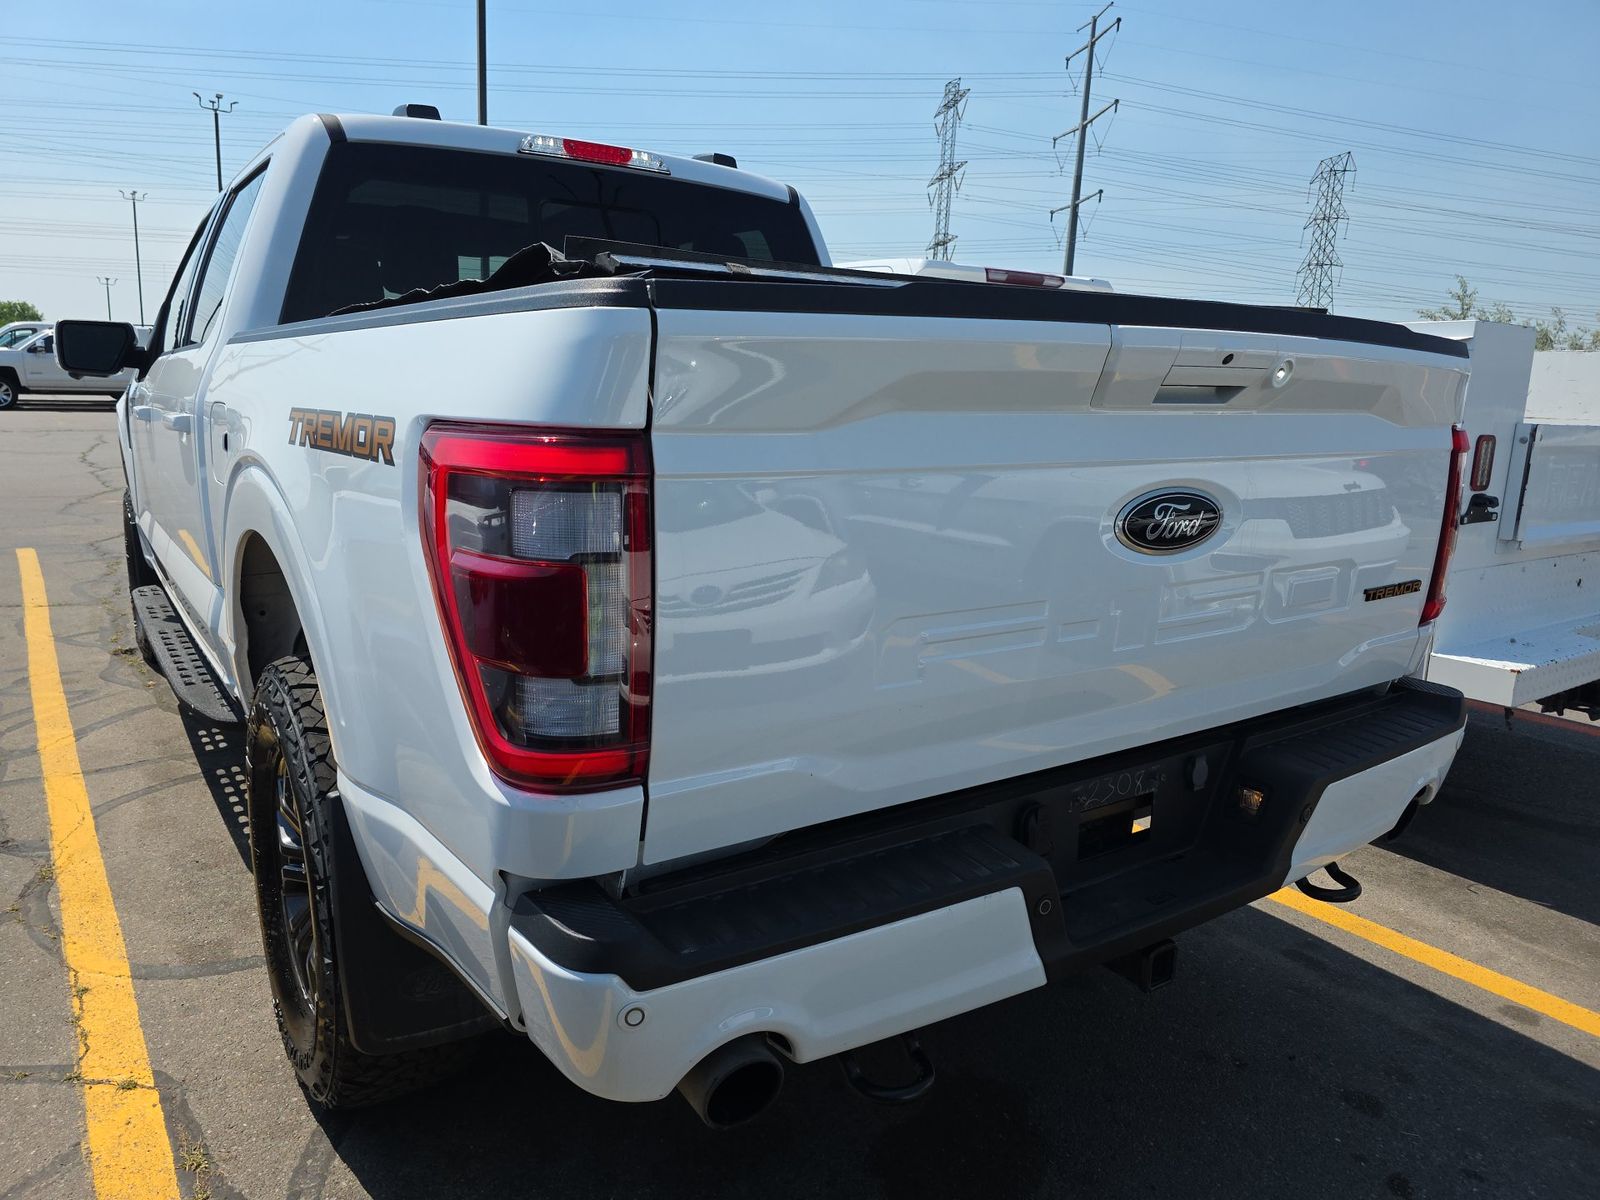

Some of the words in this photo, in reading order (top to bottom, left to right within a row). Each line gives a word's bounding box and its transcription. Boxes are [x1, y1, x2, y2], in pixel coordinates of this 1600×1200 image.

[289, 407, 396, 467] TREMOR
[1146, 503, 1204, 540] Ford
[1364, 579, 1422, 602] TREMOR
